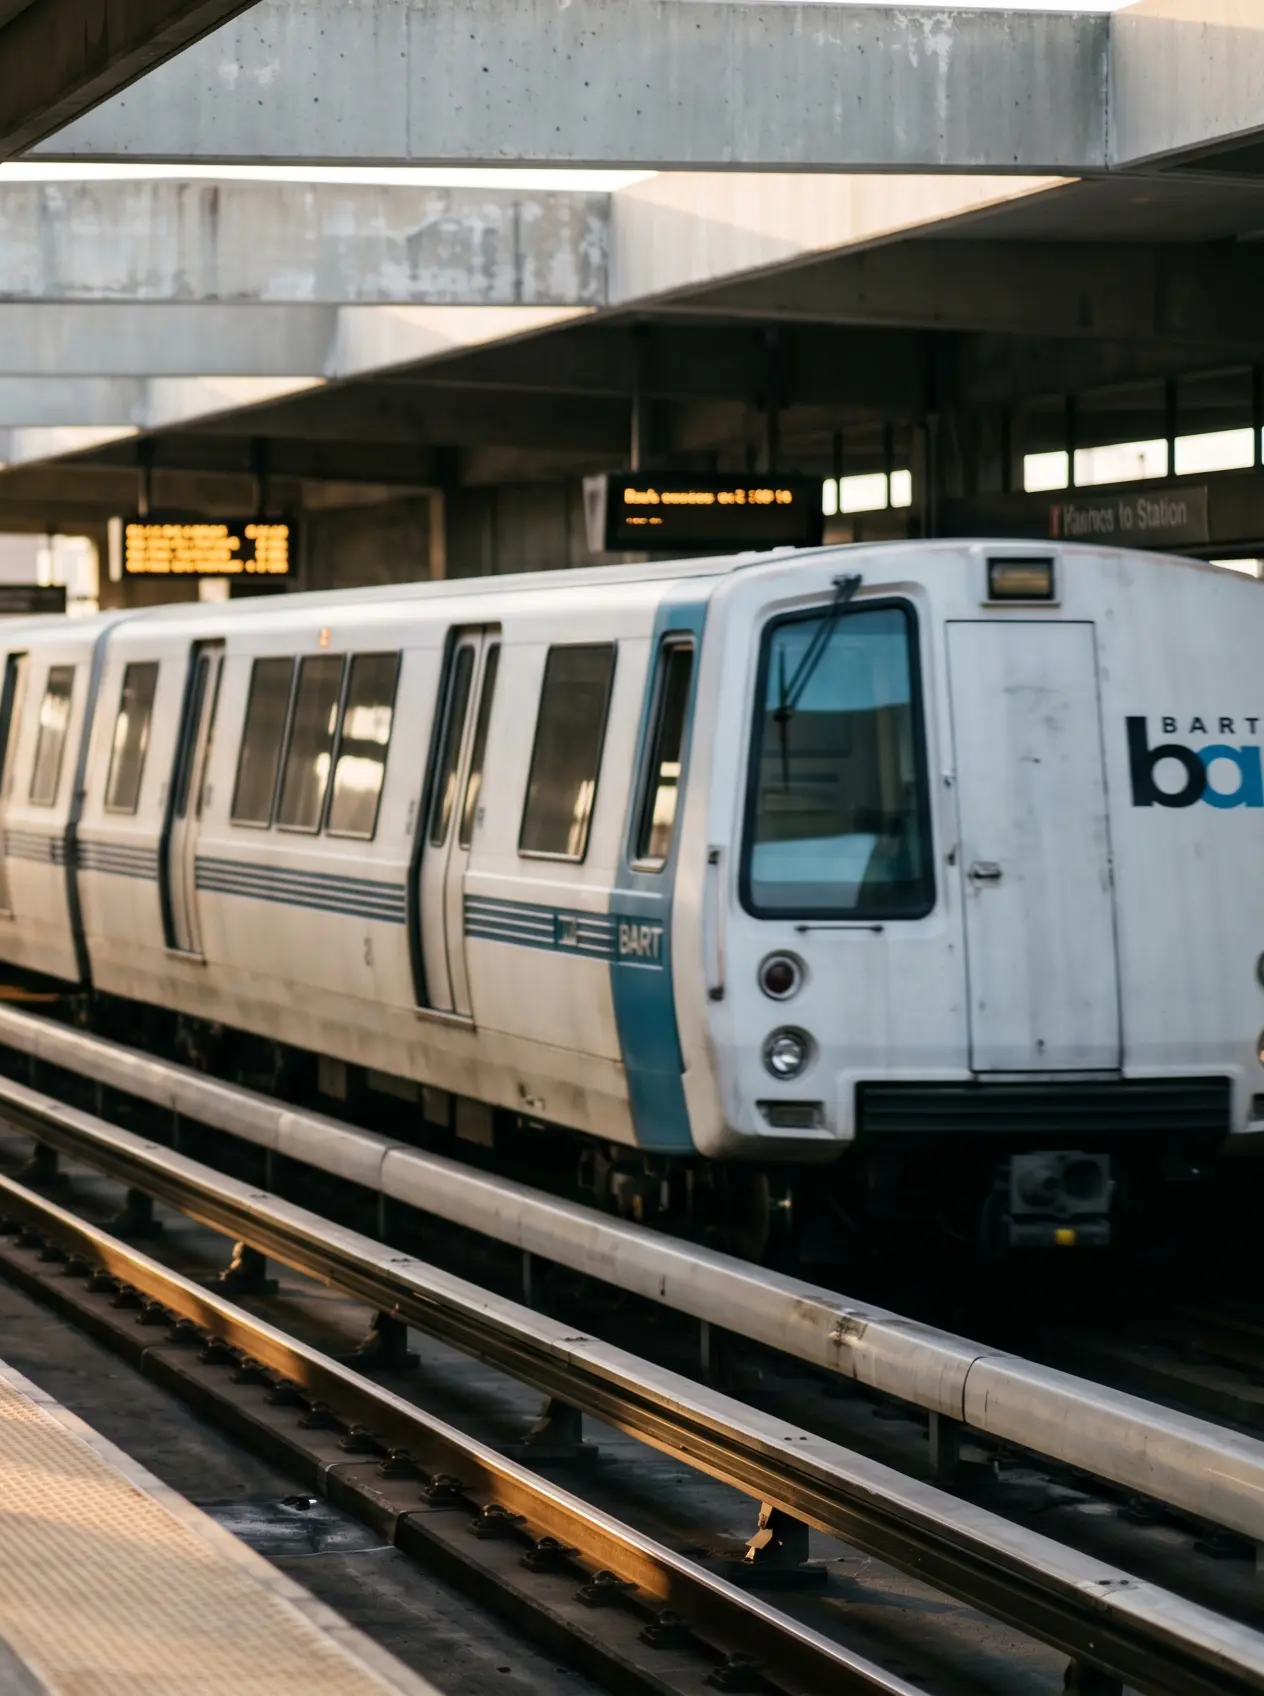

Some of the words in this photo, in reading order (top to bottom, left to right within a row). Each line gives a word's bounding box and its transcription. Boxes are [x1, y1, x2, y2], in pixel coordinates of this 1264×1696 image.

[1137, 497, 1187, 530] Station
[1161, 716, 1260, 735] BART
[618, 923, 664, 959] BART
